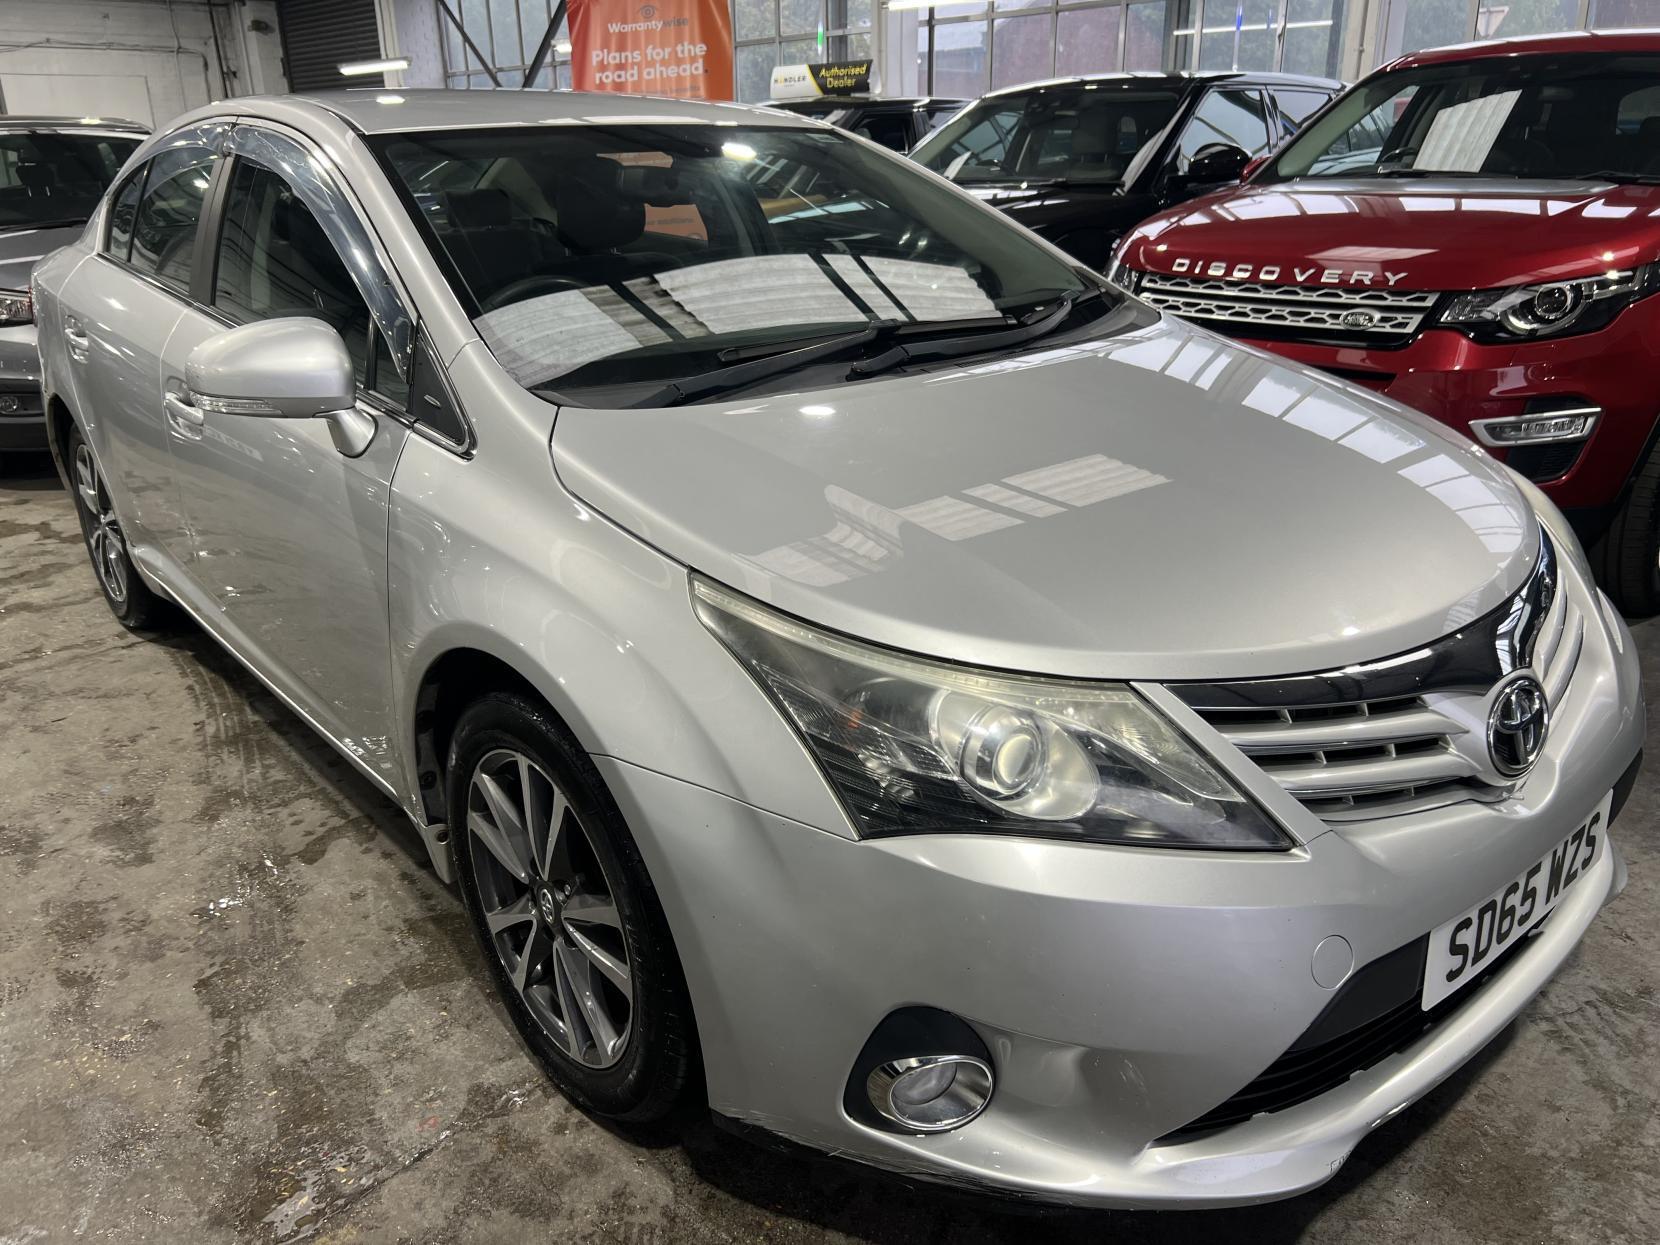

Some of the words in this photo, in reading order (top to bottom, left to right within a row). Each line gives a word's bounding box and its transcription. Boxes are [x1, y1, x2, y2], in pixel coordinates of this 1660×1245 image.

[607, 17, 689, 33] Warrantywise
[591, 48, 641, 67] Plans
[646, 45, 672, 61] for
[676, 41, 707, 58] the
[595, 65, 638, 85] road
[819, 63, 867, 78] Authorised
[826, 76, 856, 89] Dealer
[1172, 258, 1408, 286] DISCOVERY
[1445, 861, 1543, 983] SD65
[1545, 811, 1601, 906] WZS
